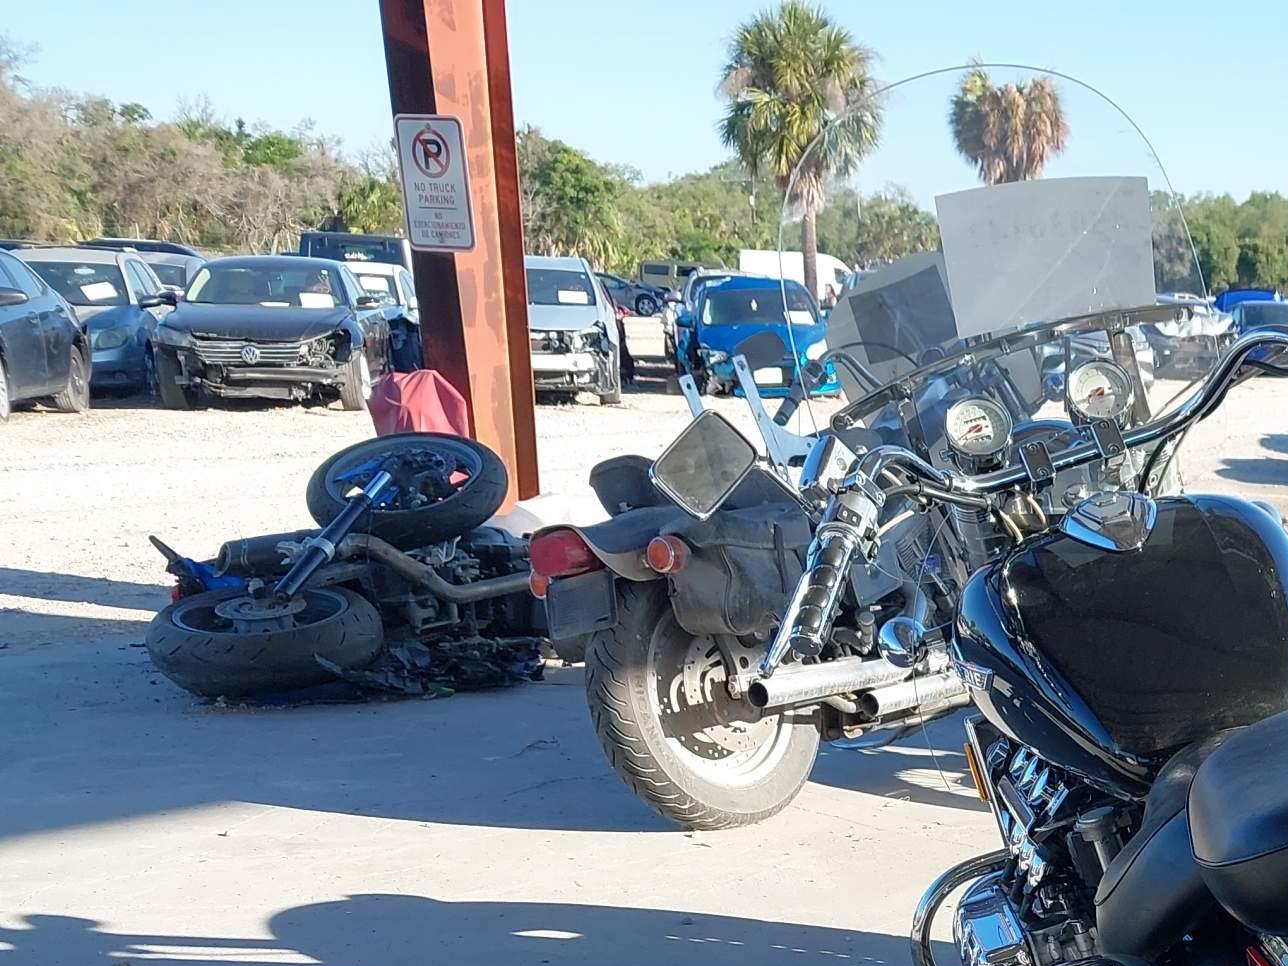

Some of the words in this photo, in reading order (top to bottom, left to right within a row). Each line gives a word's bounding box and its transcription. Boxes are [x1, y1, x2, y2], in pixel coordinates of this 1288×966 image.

[414, 182, 426, 192] NO
[429, 183, 456, 193] TRUCK
[418, 194, 455, 205] PARKING
